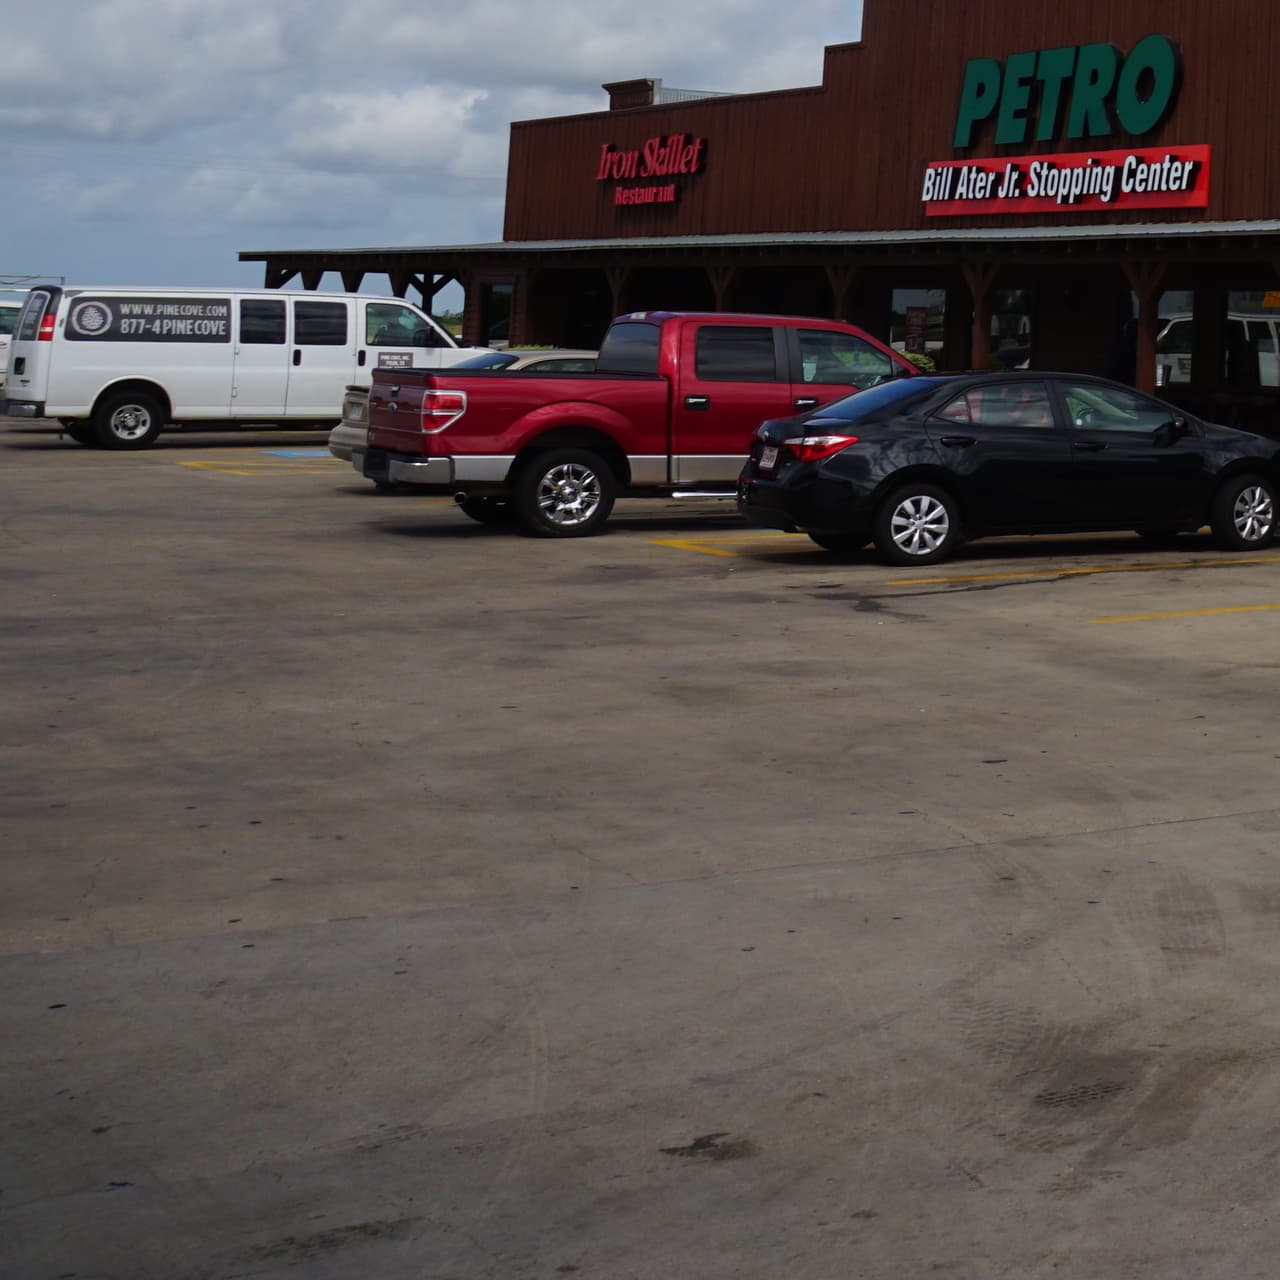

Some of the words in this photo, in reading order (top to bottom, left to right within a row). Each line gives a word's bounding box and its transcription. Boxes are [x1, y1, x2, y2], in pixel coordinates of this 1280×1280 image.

[952, 34, 1177, 148] PETRO
[596, 143, 640, 180] Iron
[640, 132, 703, 177] Skillet
[921, 166, 954, 202] Bill
[954, 165, 996, 201] Ater
[998, 163, 1021, 199] Jr.
[1027, 158, 1116, 205] Stopping
[1121, 154, 1194, 194] Center
[615, 184, 676, 206] Restaurant
[119, 303, 228, 317] WWW.PINECOVE.COM
